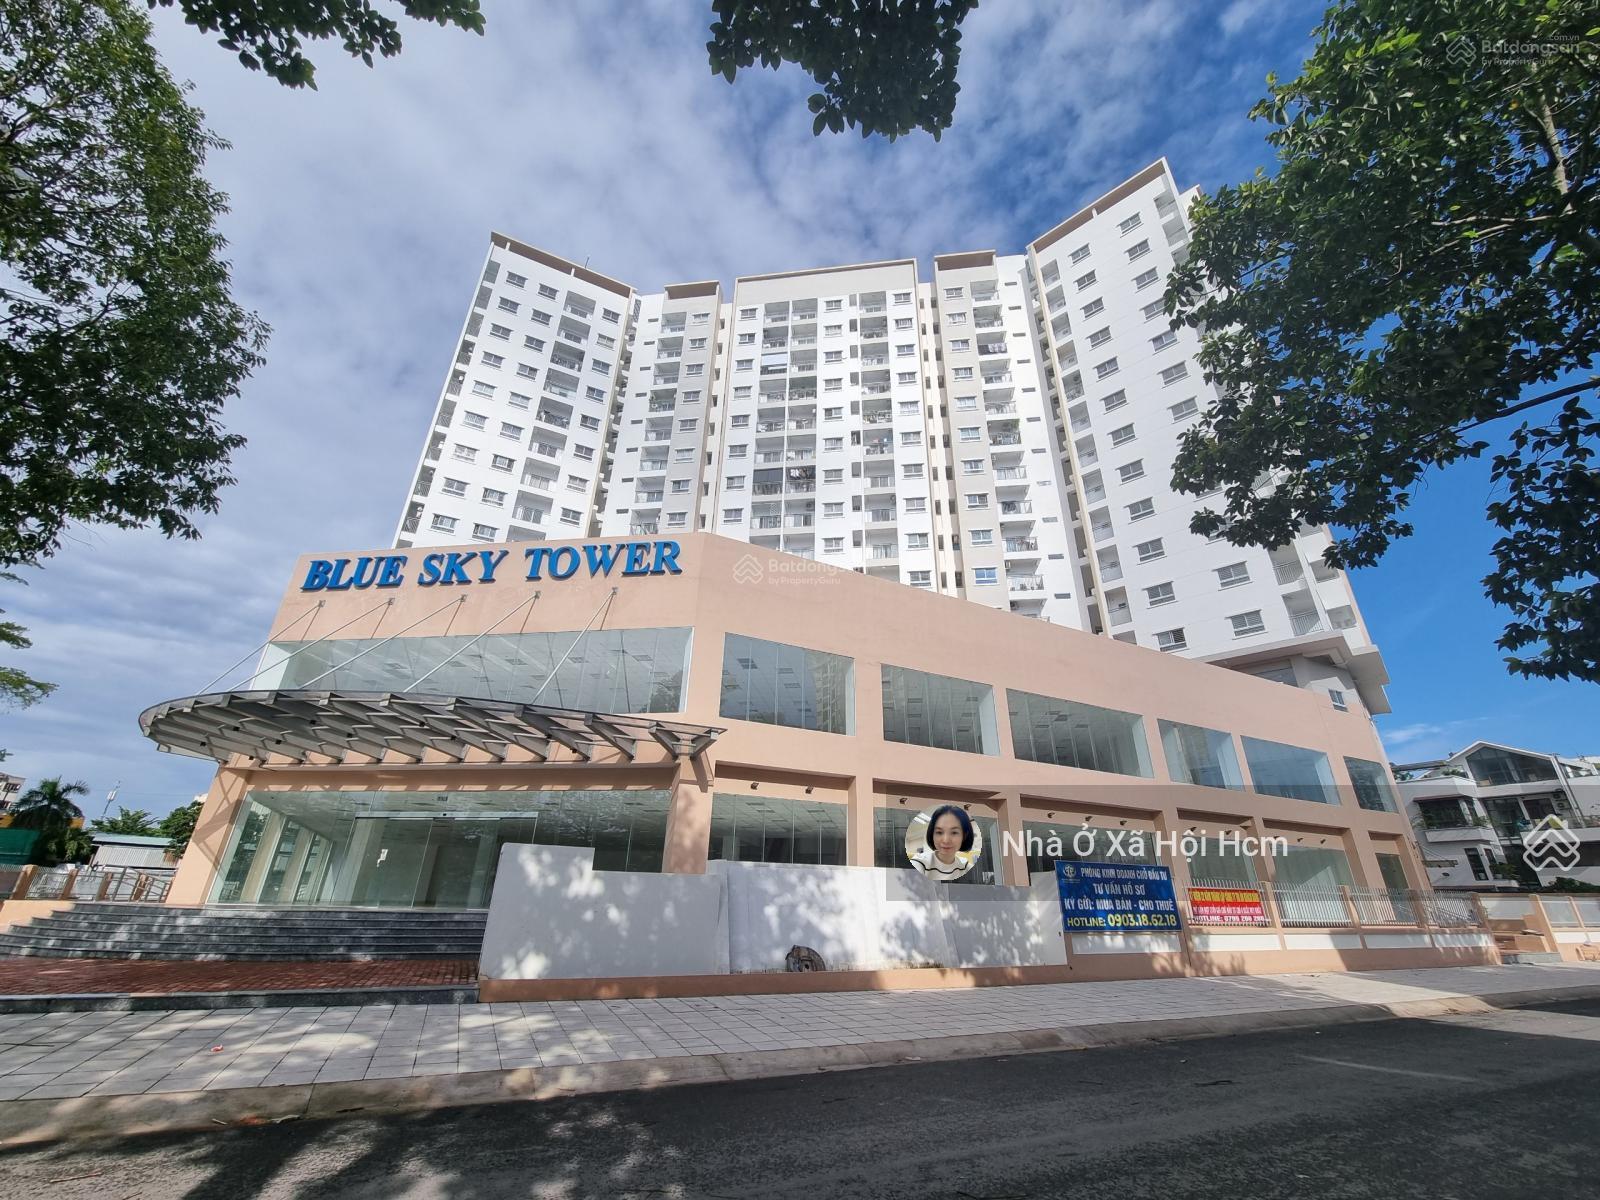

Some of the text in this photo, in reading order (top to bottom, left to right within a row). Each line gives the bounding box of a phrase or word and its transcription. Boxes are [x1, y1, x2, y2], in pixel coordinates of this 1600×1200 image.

[301, 540, 683, 591] BLUE SKY TOWER
[1116, 869, 1136, 880] DOANH
[1093, 882, 1104, 894] TƯ
[1105, 880, 1121, 894] VẤN
[1135, 883, 1146, 895] SƠ
[1064, 897, 1075, 910] KÝ
[1096, 899, 1114, 910] MUA
[1116, 897, 1132, 911] BÁN
[1138, 899, 1154, 911] CHO
[1155, 898, 1175, 911] THUÊ
[1067, 913, 1177, 927] HOTLINE: 0903.18.62.18
